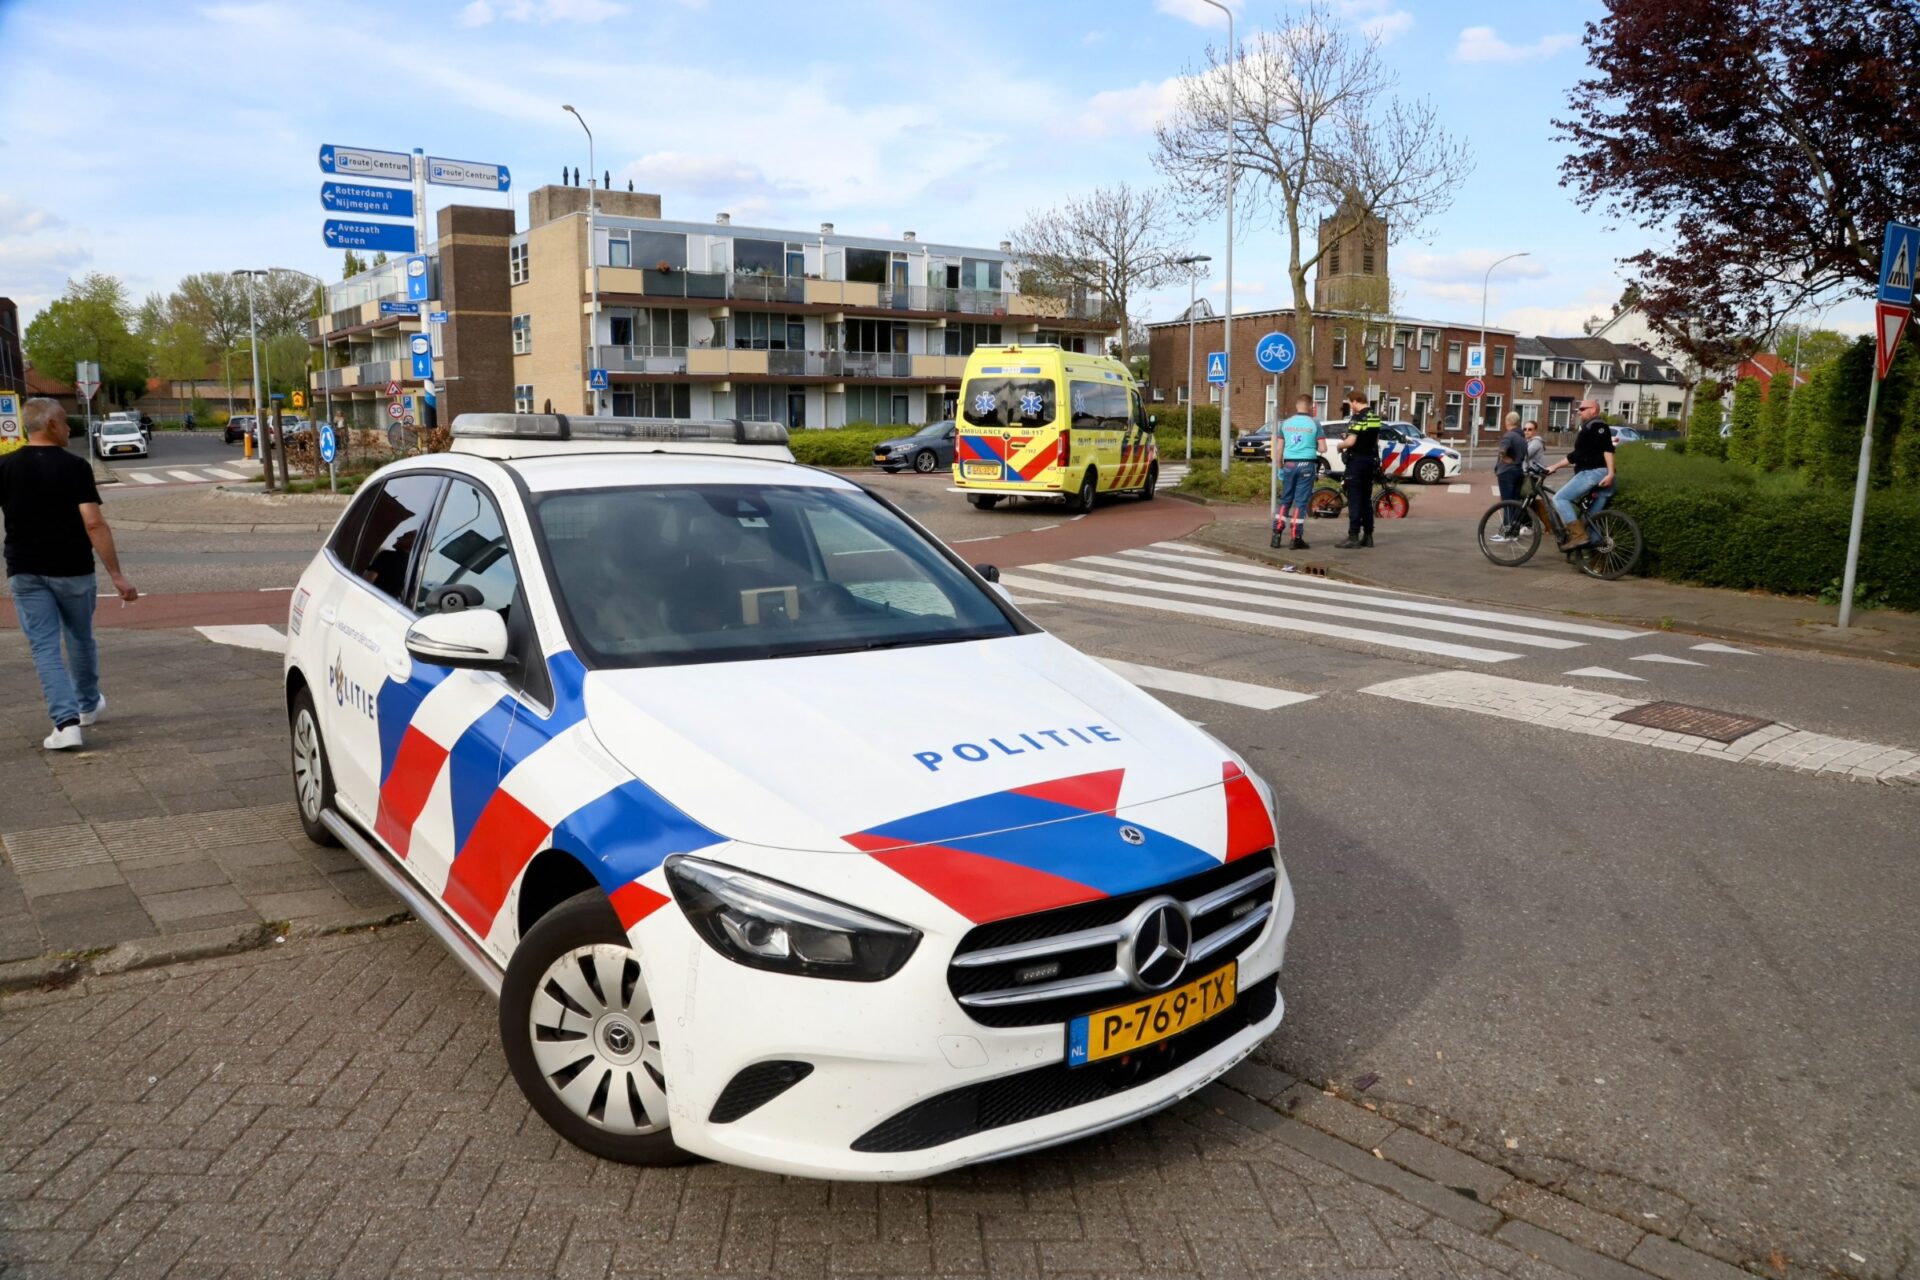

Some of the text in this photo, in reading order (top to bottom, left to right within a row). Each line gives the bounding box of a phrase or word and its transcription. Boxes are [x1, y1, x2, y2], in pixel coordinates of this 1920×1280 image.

[349, 158, 370, 167] route
[373, 160, 409, 171] Centrum
[465, 170, 497, 180] Centrum
[335, 185, 384, 198] Rotterdam
[336, 198, 380, 211] Nijmegen
[338, 223, 380, 234] Avezaath
[338, 235, 366, 245] Buren
[391, 406, 402, 414] 30
[912, 725, 1122, 772] POLITIE
[1103, 972, 1226, 1051] P-769-TX
[1071, 1045, 1085, 1058] NL
